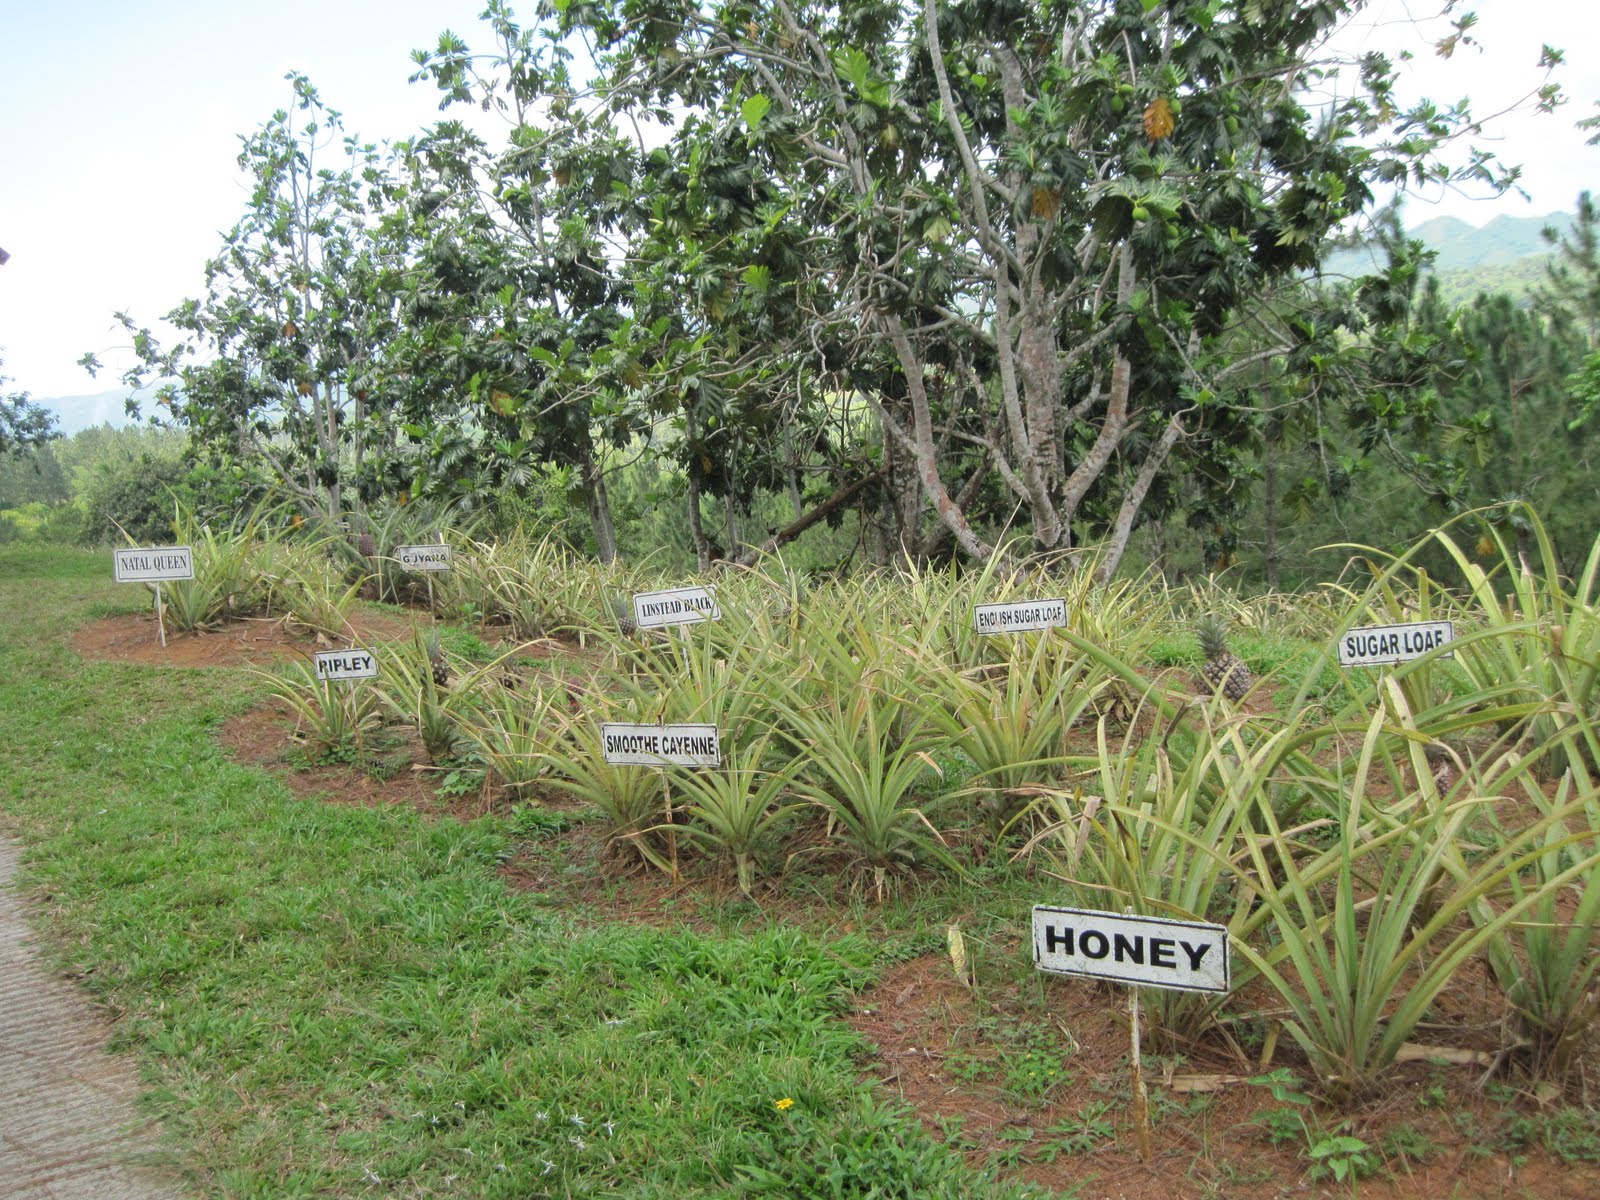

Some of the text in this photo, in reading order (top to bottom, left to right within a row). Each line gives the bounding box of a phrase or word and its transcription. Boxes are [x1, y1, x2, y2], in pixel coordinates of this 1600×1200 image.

[121, 554, 187, 572] NATAL QUEEN
[641, 597, 712, 617] LINSTEAD BLACK
[1013, 608, 1041, 623] SUGAR
[1042, 606, 1061, 621] LOAF
[1346, 629, 1443, 658] SUGAR LOAF
[318, 656, 371, 673] RIPLEY
[606, 735, 715, 755] SMOOTHE CAYENNE
[1045, 925, 1212, 971] HONEY
